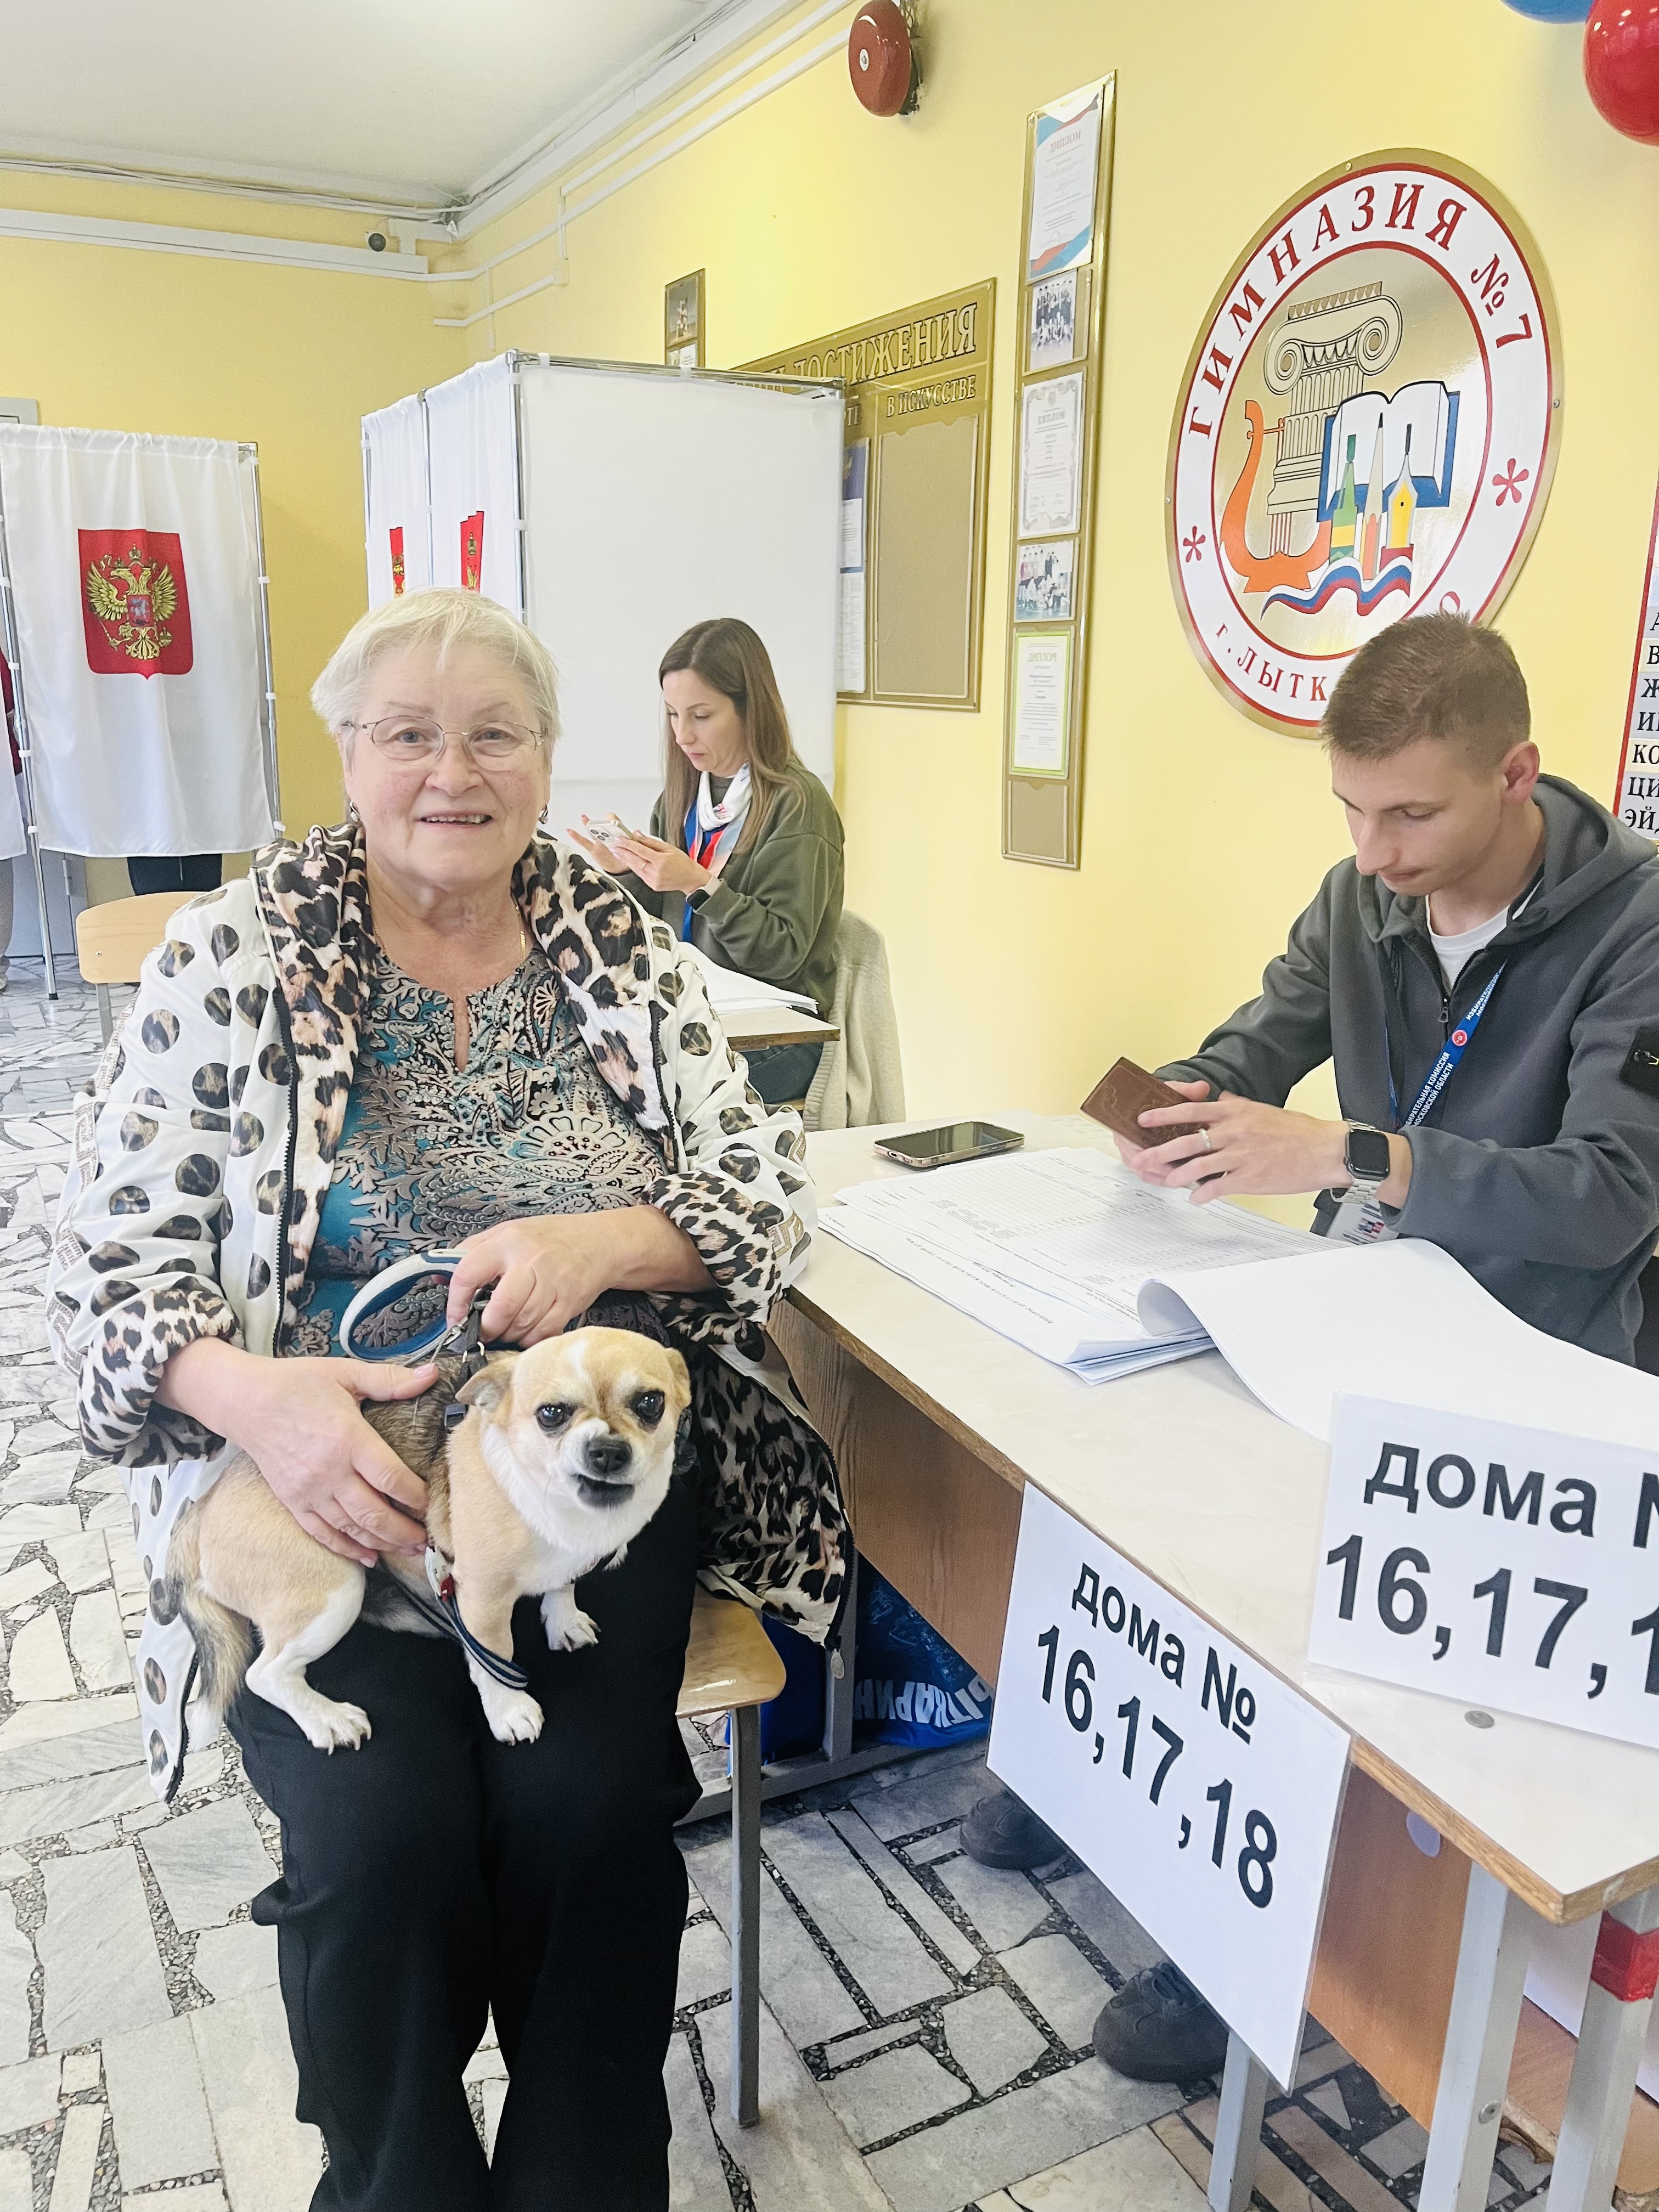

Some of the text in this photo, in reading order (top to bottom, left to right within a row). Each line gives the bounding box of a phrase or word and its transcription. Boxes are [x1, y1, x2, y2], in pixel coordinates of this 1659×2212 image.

[1188, 183, 1532, 439] ГИМНАЗИЯ № 7
[886, 374, 977, 417] В ИСКУССТВЕ
[1037, 410, 1065, 425] ДИПЛОМ
[1028, 652, 1057, 662] ДИПЛОМ
[1632, 744, 1659, 765] КО
[1628, 777, 1659, 800] ЦИ
[1625, 805, 1659, 835] ЭЙ
[1405, 1052, 1451, 1126] БИРАТЕЛЬНАЯ КОМИССИЯ
[1435, 1063, 1454, 1090] ОБЛАСТИ
[1363, 1441, 1598, 1538] дома
[1327, 1534, 1659, 1700] 16,17,1
[1072, 1562, 1257, 1745] дома №
[853, 1673, 994, 1728] ЫТКАРИН
[1037, 1624, 1278, 1910] 16,17,18
